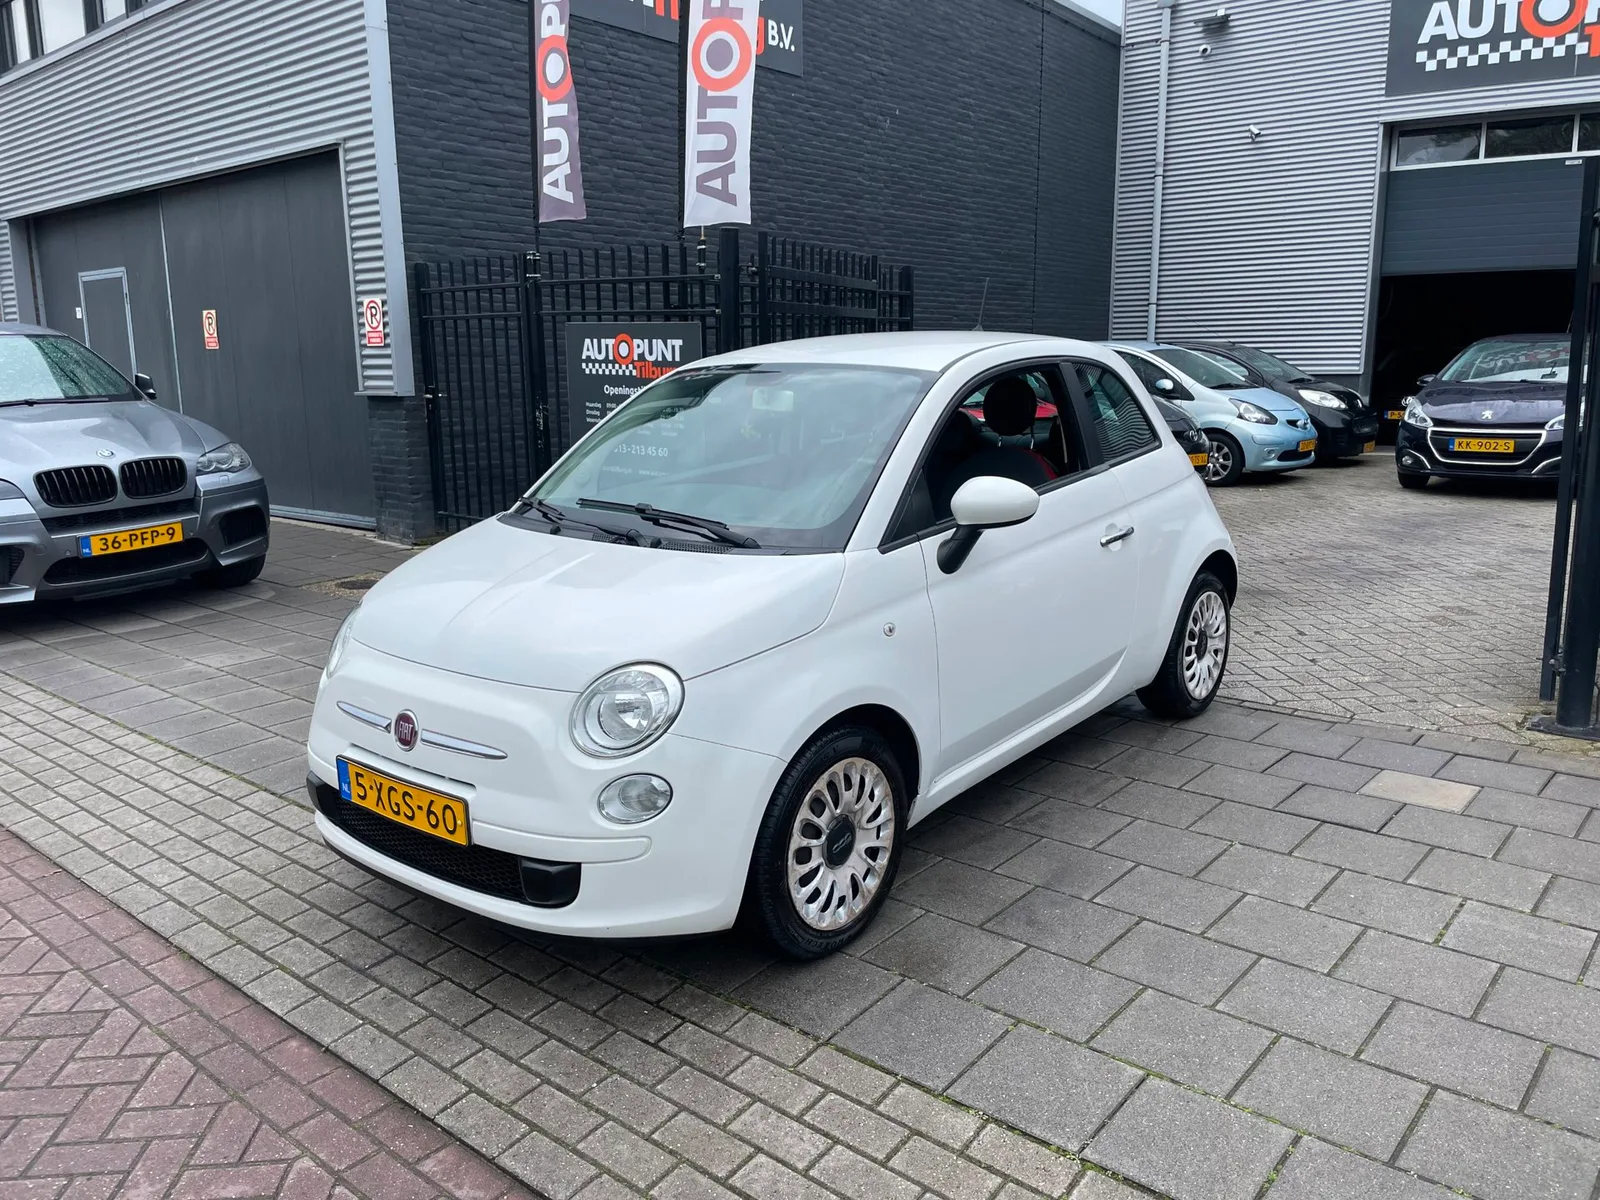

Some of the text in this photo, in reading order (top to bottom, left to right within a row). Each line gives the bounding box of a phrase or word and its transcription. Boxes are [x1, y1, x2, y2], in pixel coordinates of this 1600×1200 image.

[767, 19, 796, 52] B.V.
[537, 0, 574, 204] AUTOP
[581, 333, 683, 365] AUTOPUNT
[633, 361, 676, 379] Tilbu
[646, 446, 657, 457] 45
[658, 447, 669, 457] 60
[1457, 440, 1511, 451] KK-902-S
[99, 526, 176, 552] 36-PFP-9
[354, 769, 458, 836] 5-XGS-60
